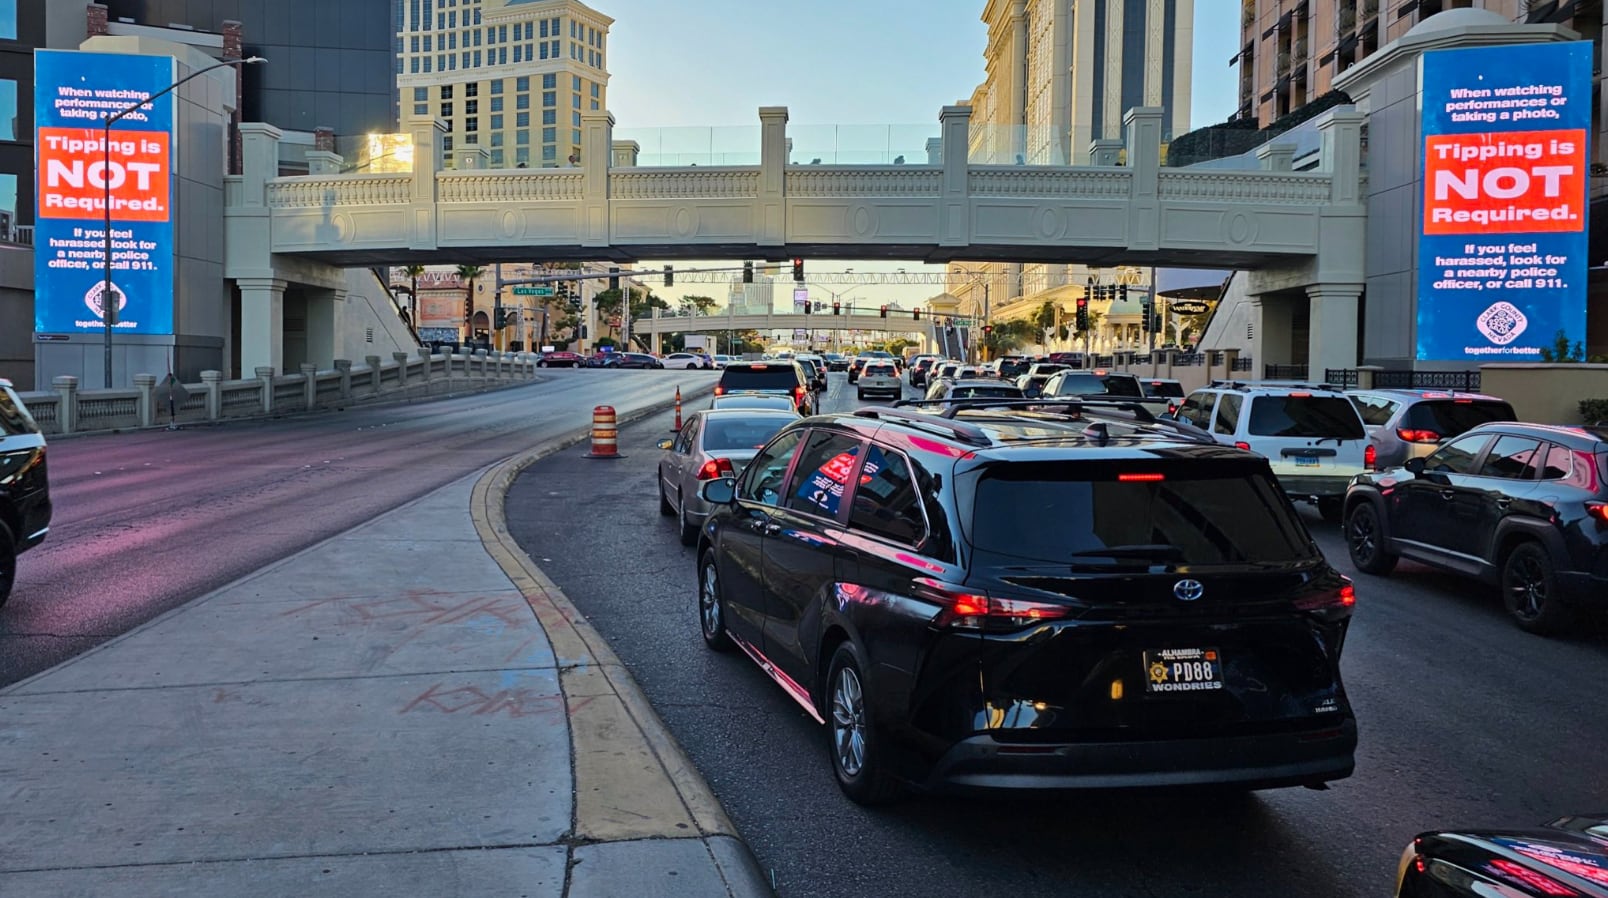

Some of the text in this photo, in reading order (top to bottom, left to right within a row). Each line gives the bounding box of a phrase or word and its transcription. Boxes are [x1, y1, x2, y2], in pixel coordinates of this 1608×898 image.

[58, 87, 150, 100] When watching
[1450, 85, 1562, 98] When watching
[55, 98, 138, 109] performances
[1446, 97, 1567, 112] performances or
[60, 108, 97, 120] taking
[1452, 109, 1559, 122] taking a photo,
[45, 135, 160, 155] Tipping is
[1433, 139, 1575, 162] Tipping is
[47, 159, 160, 190] NOT
[1435, 165, 1574, 200] NOT
[46, 193, 164, 212] Required.
[1432, 204, 1577, 225] Required.
[74, 228, 132, 239] If you feel
[111, 240, 137, 248] look
[139, 241, 156, 249] for
[1464, 243, 1536, 255] If you feel
[112, 251, 149, 260] police
[1435, 254, 1567, 267] harassed, look for
[48, 259, 157, 270] officer, or call 911.
[1444, 266, 1558, 279] a nearby police
[1433, 278, 1568, 290] officer, or call 911.
[1480, 303, 1523, 323] CLARK COUNTY
[1487, 332, 1516, 343] NEVADA
[1161, 648, 1201, 657] ALHAMBRA
[1173, 661, 1213, 682] PD88
[1152, 681, 1222, 692] WONDRIES
